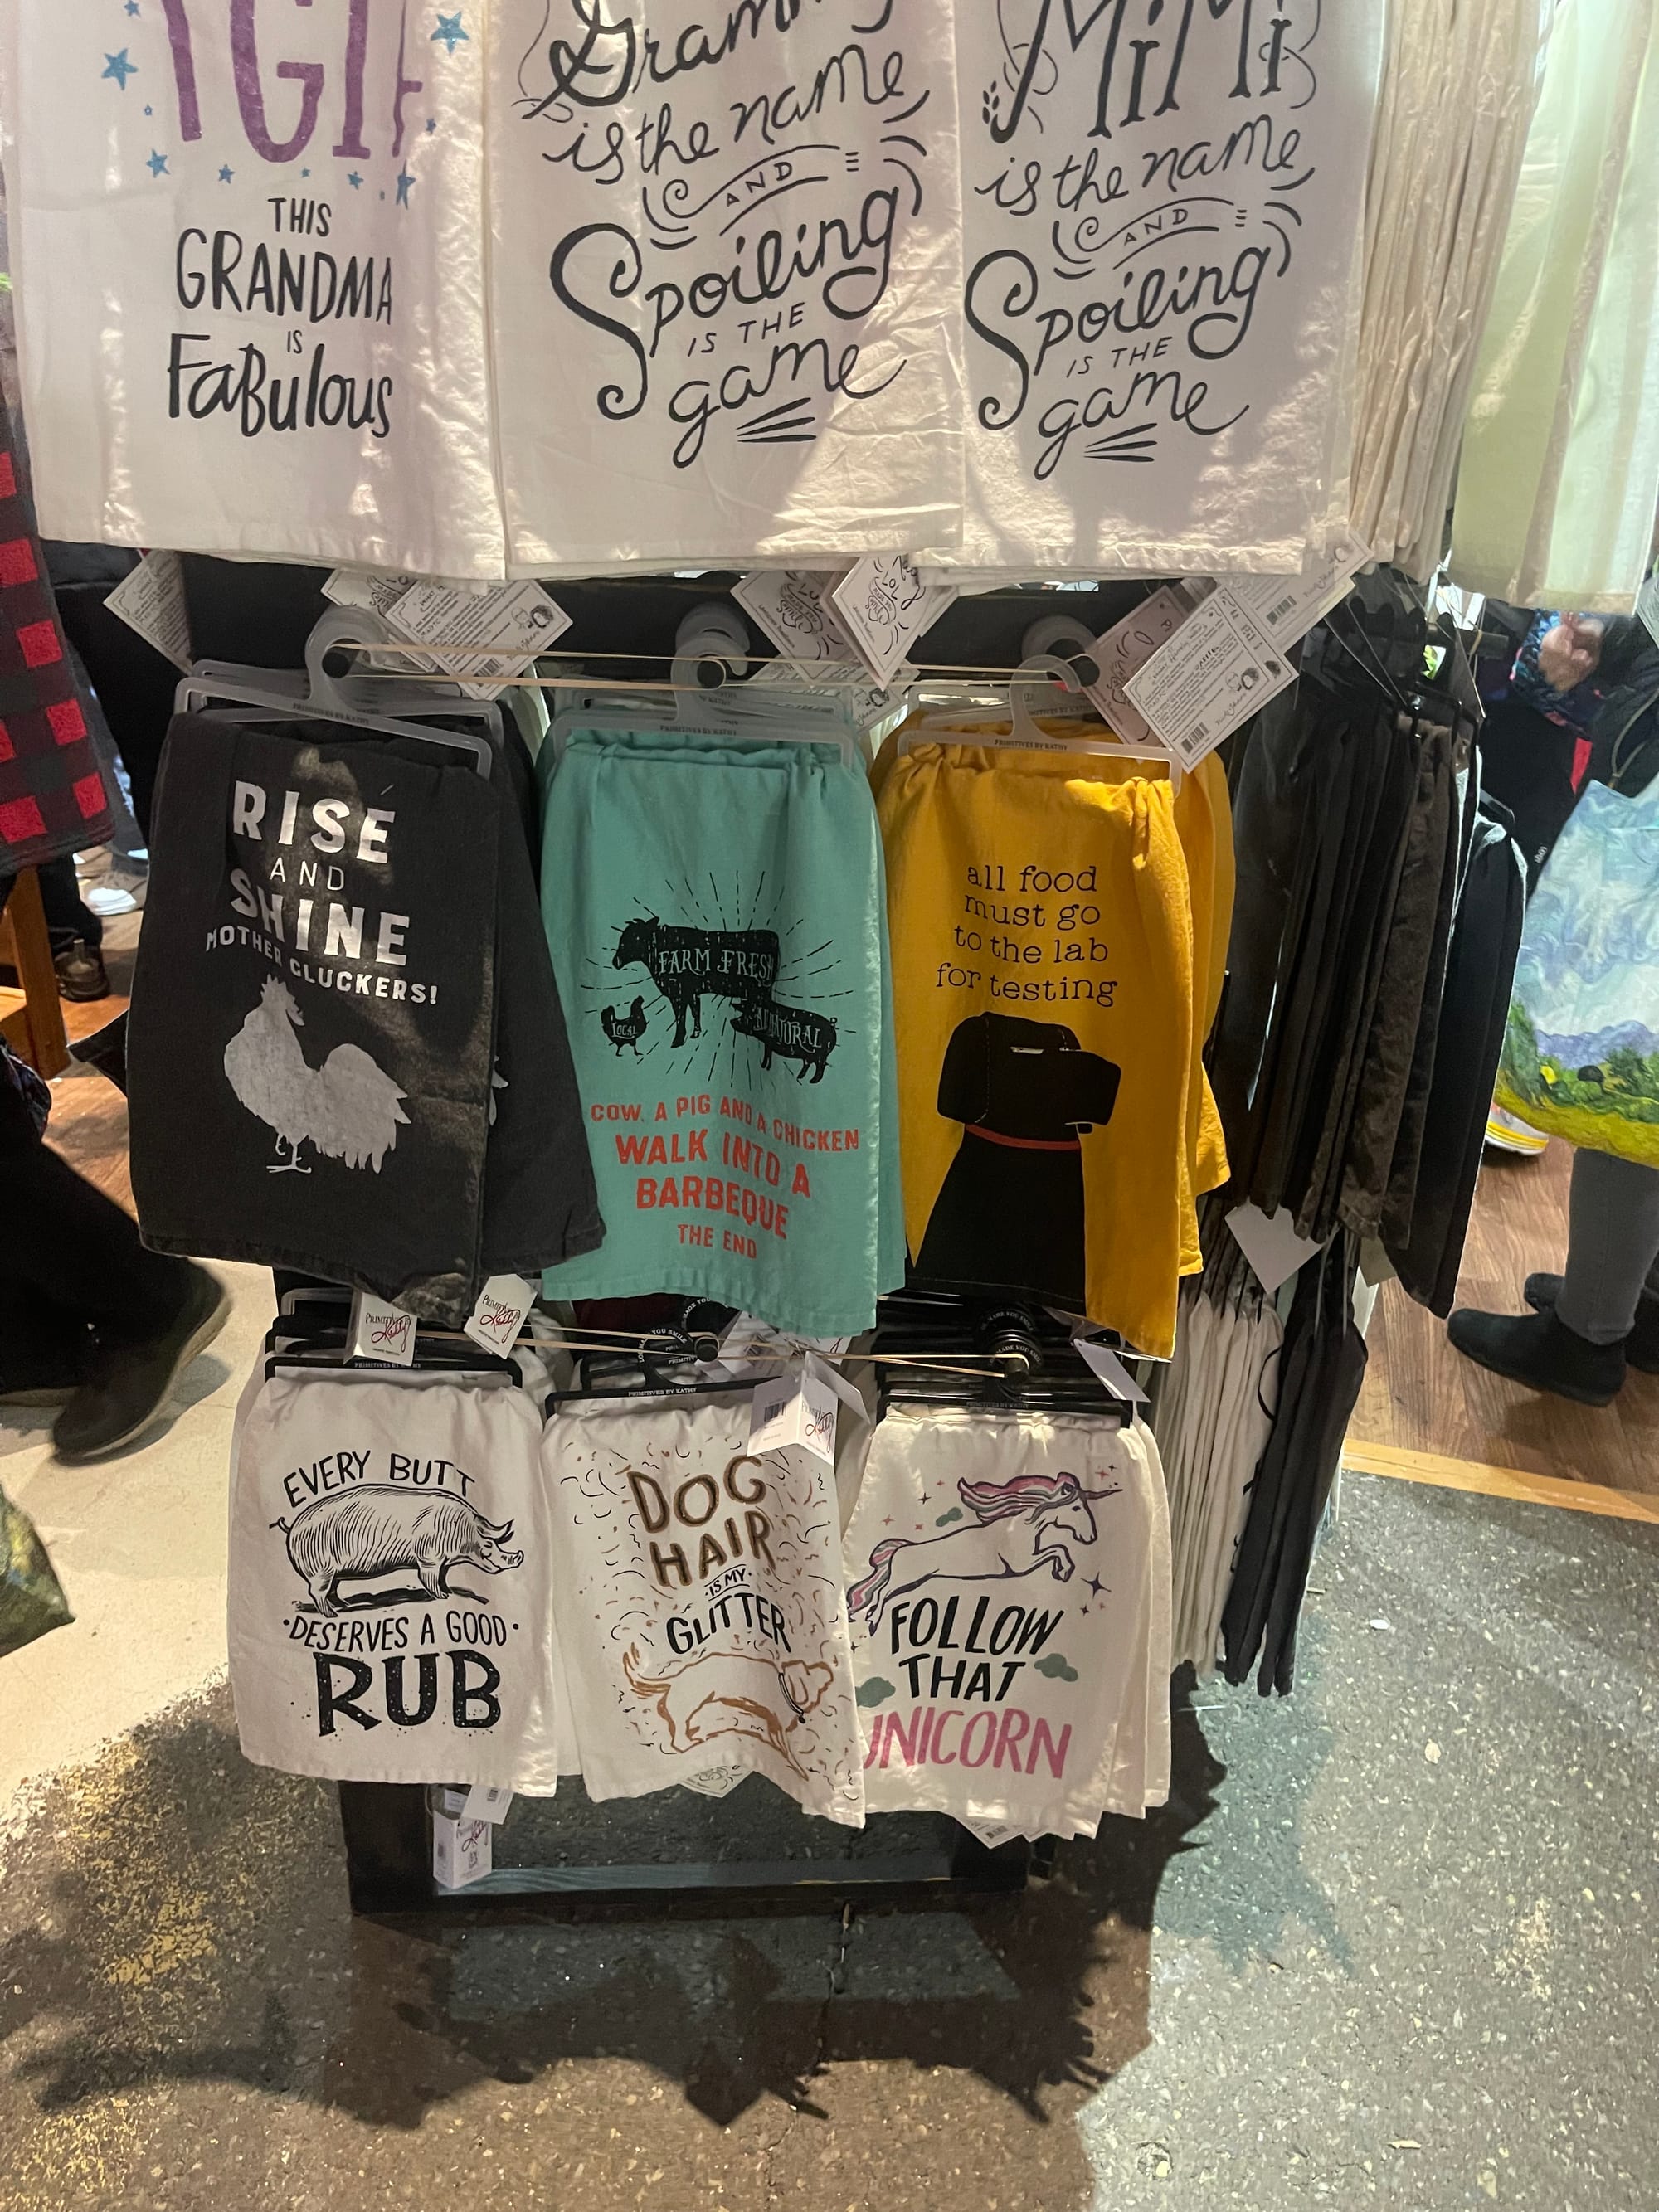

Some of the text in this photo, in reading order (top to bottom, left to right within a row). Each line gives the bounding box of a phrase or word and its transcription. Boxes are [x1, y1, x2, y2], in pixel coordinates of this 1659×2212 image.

[543, 45, 903, 183] is the name
[727, 162, 793, 206] AND
[975, 114, 1301, 215] is the name
[267, 197, 331, 236] THIS
[1123, 209, 1188, 245] AND
[176, 228, 392, 325] GRANDMA
[550, 187, 898, 420] Spoiling
[286, 329, 302, 354] IS
[688, 303, 805, 357] IS THE
[964, 247, 1270, 430] Spoiling
[1067, 336, 1172, 378] IS THE
[669, 338, 907, 468] game
[1034, 371, 1249, 480] game
[233, 780, 395, 863] RISE
[270, 858, 345, 891] AND
[967, 865, 1098, 892] all food
[230, 868, 410, 966] SHINE
[964, 894, 1101, 931] must go
[206, 925, 437, 1005] MOTHER CLUCKERS!
[658, 948, 774, 987] FARM FRESH
[954, 926, 1109, 964] to the lab
[936, 963, 1118, 1008] for testing
[655, 1101, 667, 1121] A
[676, 1094, 711, 1117] PIG
[720, 1096, 752, 1125] AND
[757, 1112, 767, 1134] A
[773, 1118, 859, 1152] CHICKEN
[615, 1128, 810, 1198] WALK INTO A
[636, 1175, 789, 1240] BARBEQUE
[677, 1223, 757, 1259] THE END
[283, 1450, 475, 1508] EVERY BUTT
[627, 1454, 766, 1534] DOG
[649, 1510, 776, 1587] HAIR
[708, 1568, 746, 1596] IS MY
[420, 1613, 435, 1646] A
[446, 1610, 507, 1646] GOOD
[666, 1592, 791, 1655] GLITTER
[891, 1595, 1064, 1655] FOLLOW
[313, 1649, 501, 1737] RUB
[898, 1653, 1027, 1703] THAT
